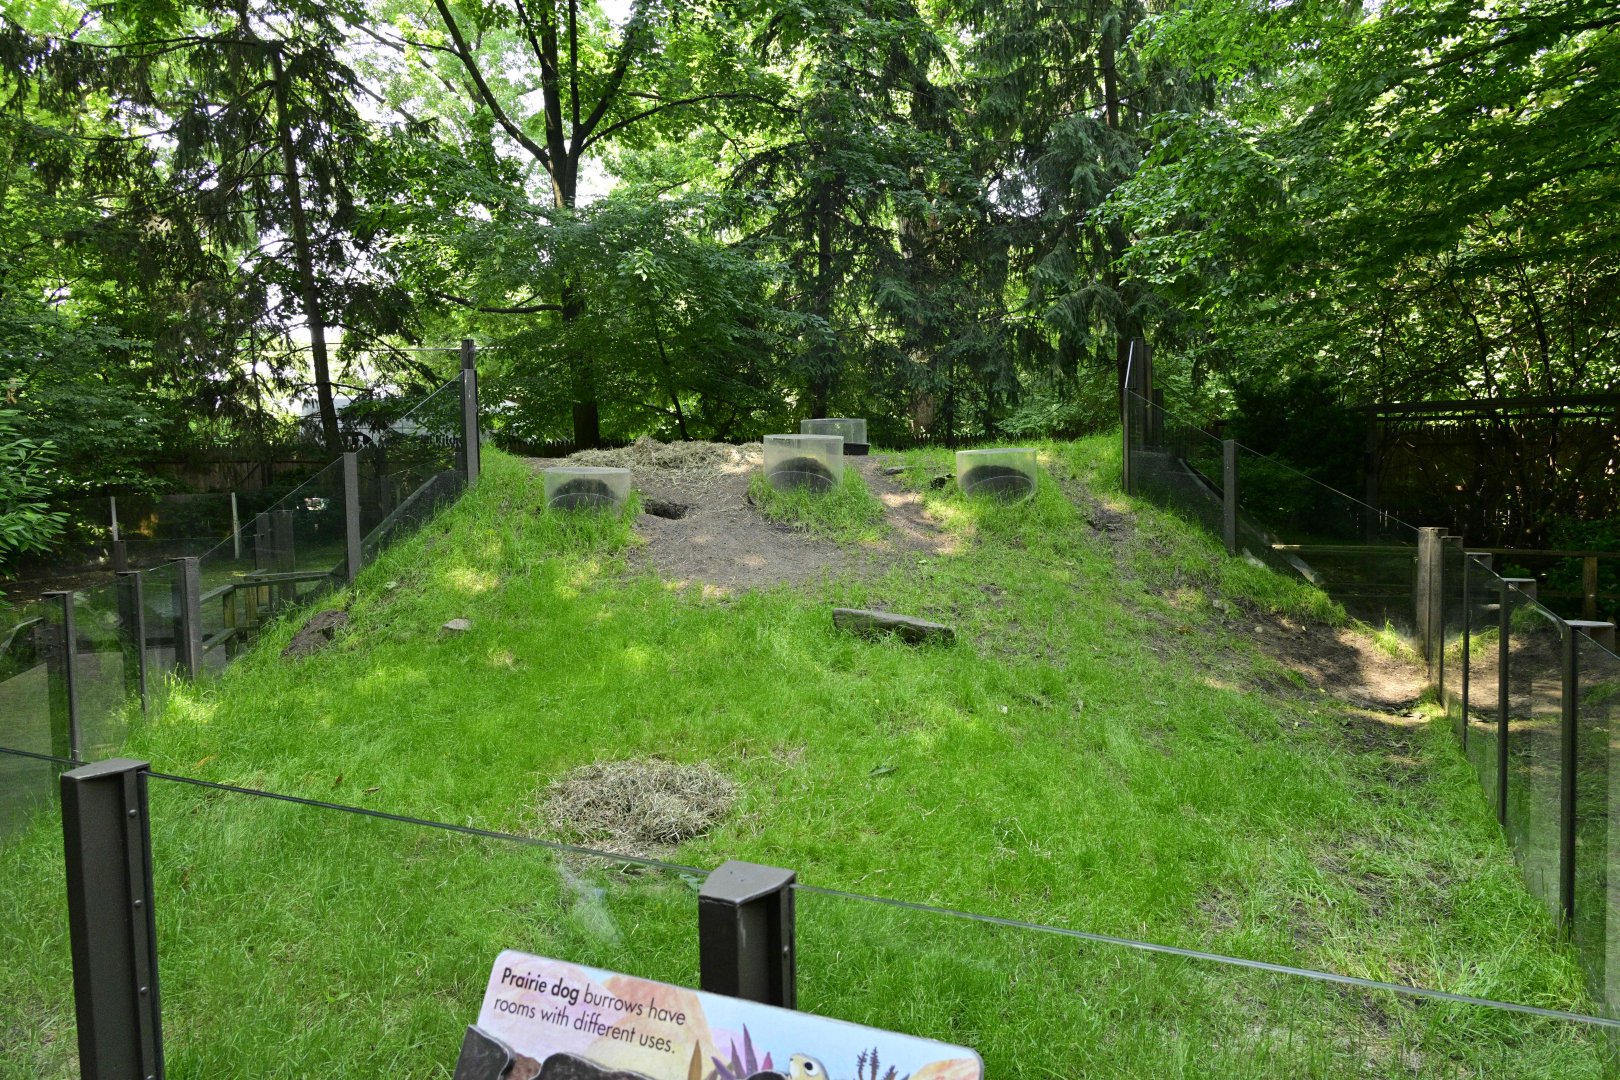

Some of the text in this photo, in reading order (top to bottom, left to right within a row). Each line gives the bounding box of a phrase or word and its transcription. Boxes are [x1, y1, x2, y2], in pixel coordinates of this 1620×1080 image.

[501, 967, 686, 1026] Prairie dog burrows have
[494, 998, 676, 1054] rooms with different uses.
